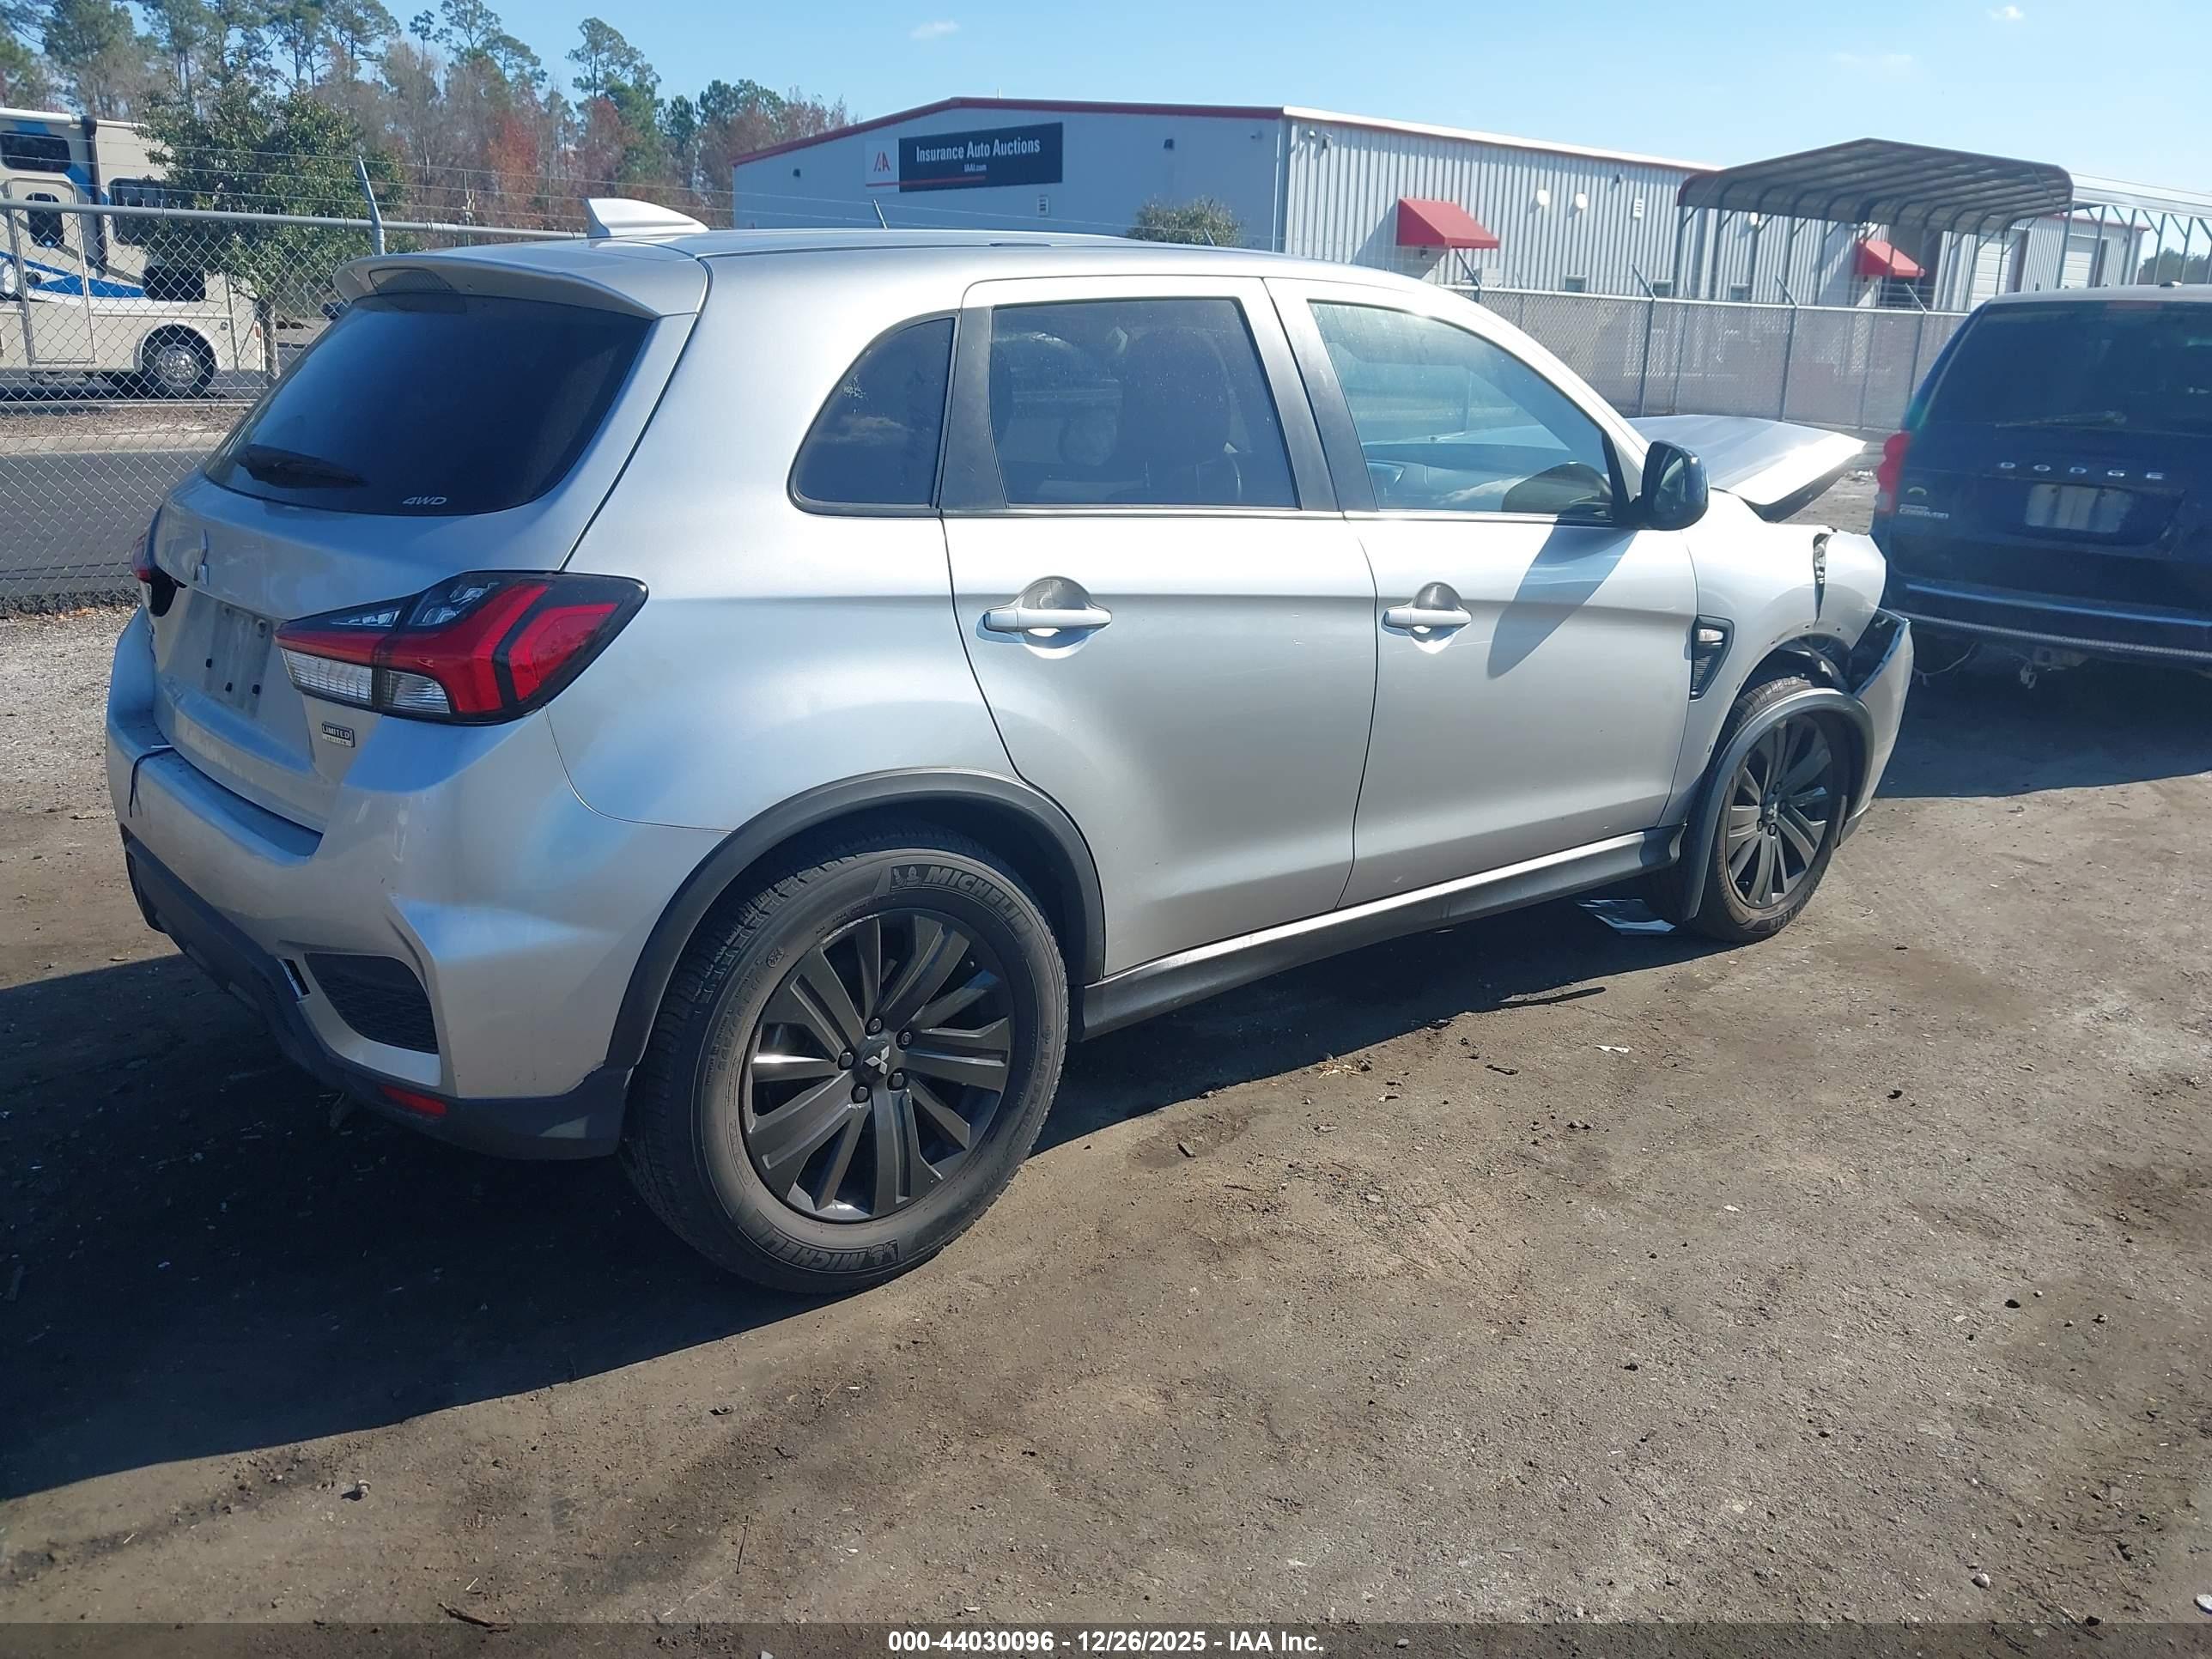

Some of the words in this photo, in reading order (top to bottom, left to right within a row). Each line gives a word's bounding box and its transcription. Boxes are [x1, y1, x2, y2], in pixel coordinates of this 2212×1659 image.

[916, 145, 964, 163] Insurance
[966, 140, 991, 159] Auto
[993, 137, 1041, 156] Auctions
[1999, 461, 2164, 480] DODGE
[402, 496, 447, 505] 4WD
[322, 725, 350, 739] LIMITED
[924, 866, 1033, 937] MICHELIN
